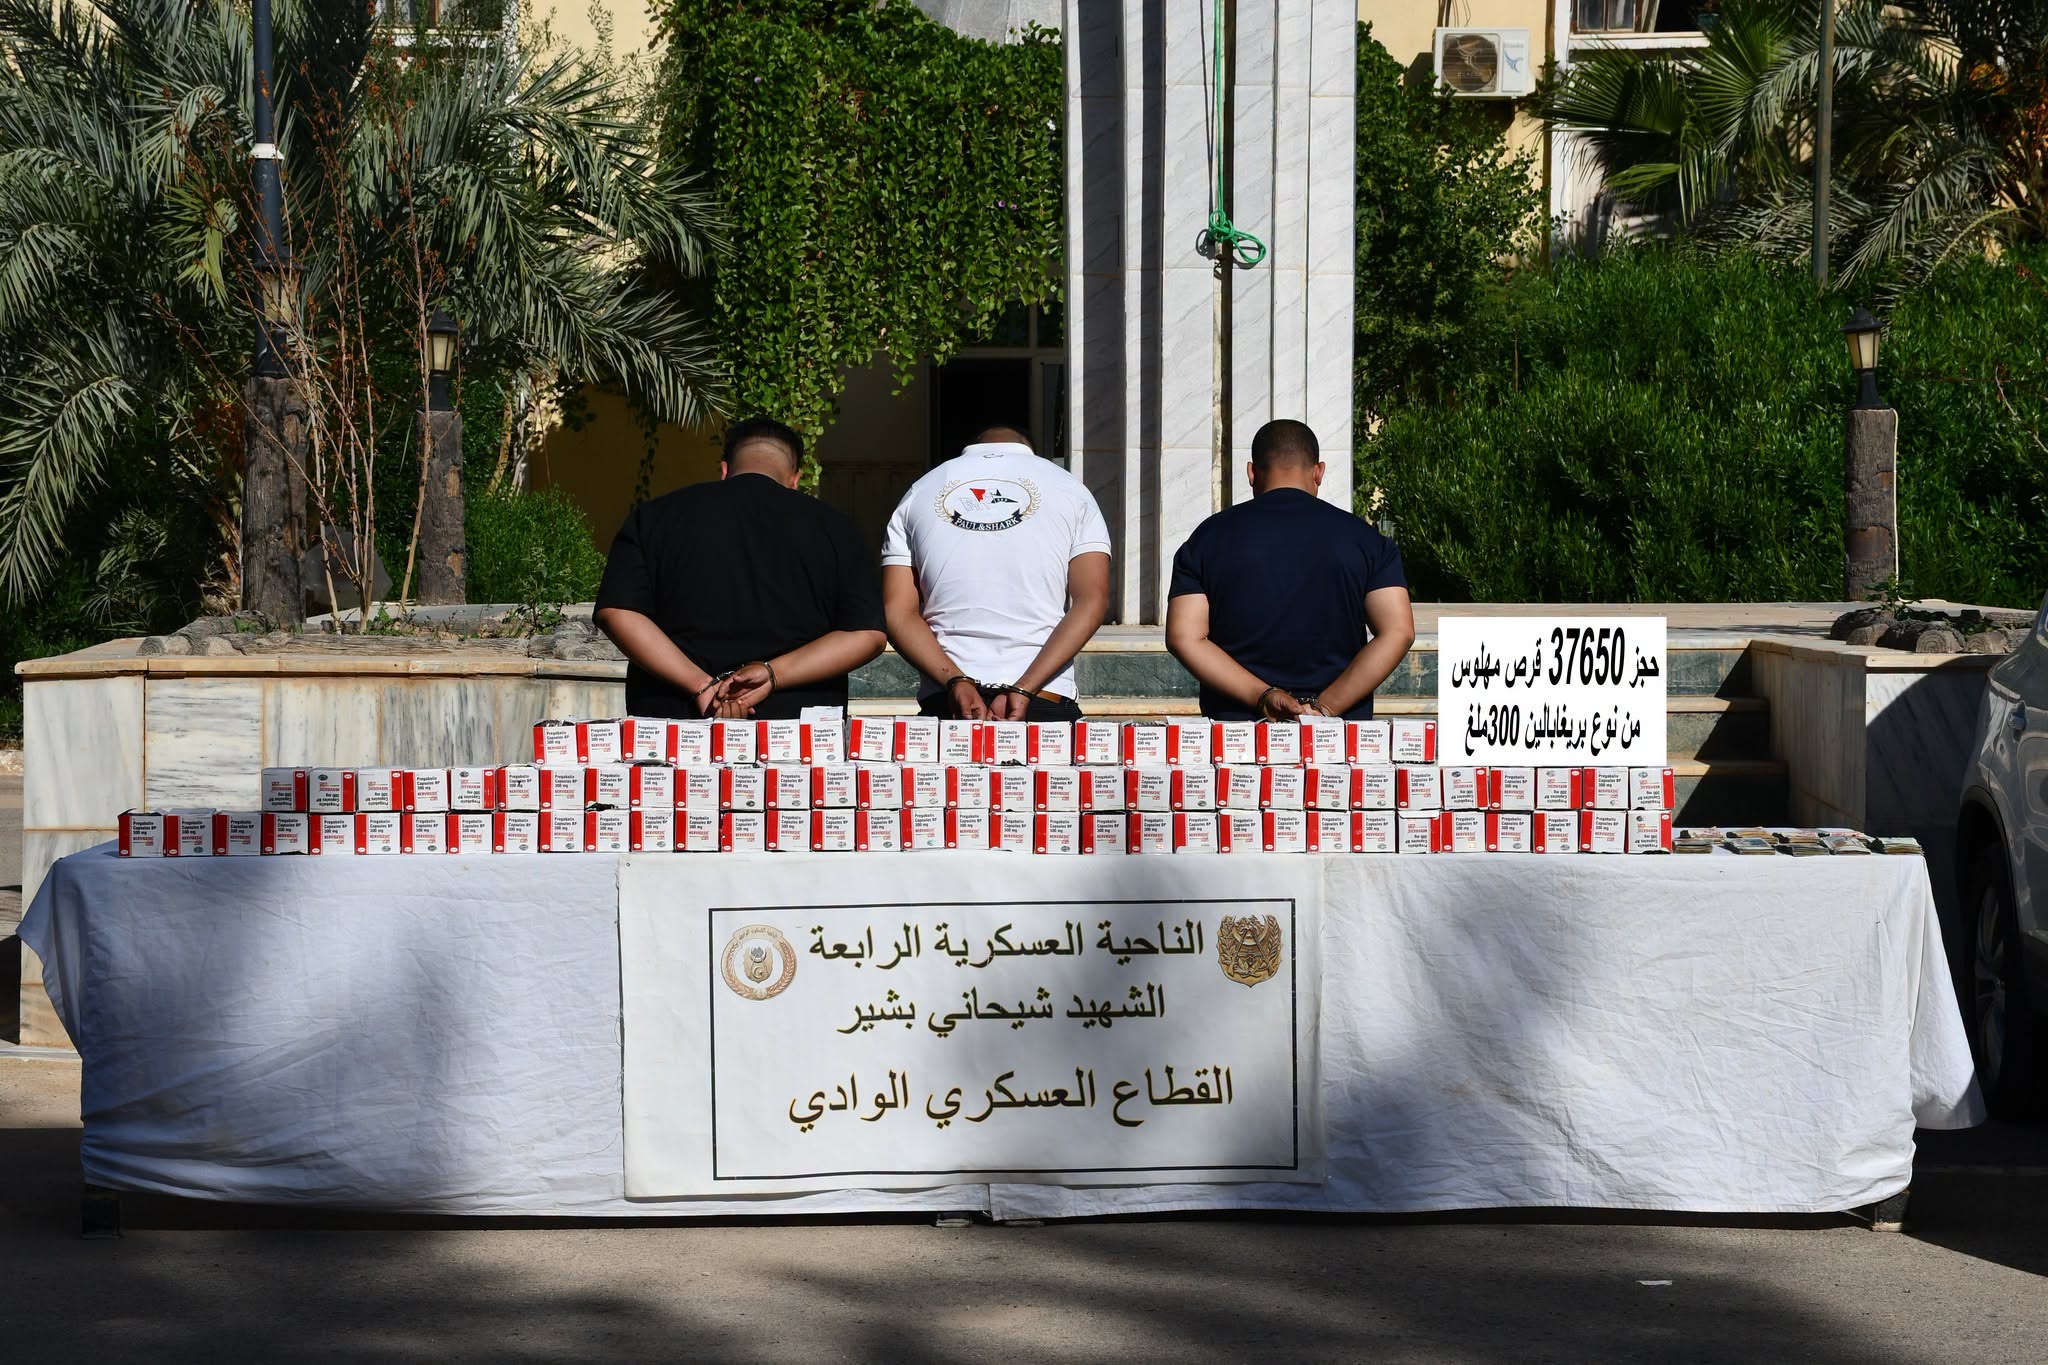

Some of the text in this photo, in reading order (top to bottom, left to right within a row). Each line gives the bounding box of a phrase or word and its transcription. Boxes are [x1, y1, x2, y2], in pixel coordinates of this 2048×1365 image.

[955, 517, 1019, 531] PAUL&SHARK
[809, 919, 1204, 970] الناحية العسكرية الرابعة
[837, 982, 1165, 1038] الشهيد شيحاني بشير
[789, 1065, 1233, 1133] القطاع العسكري الوادي
